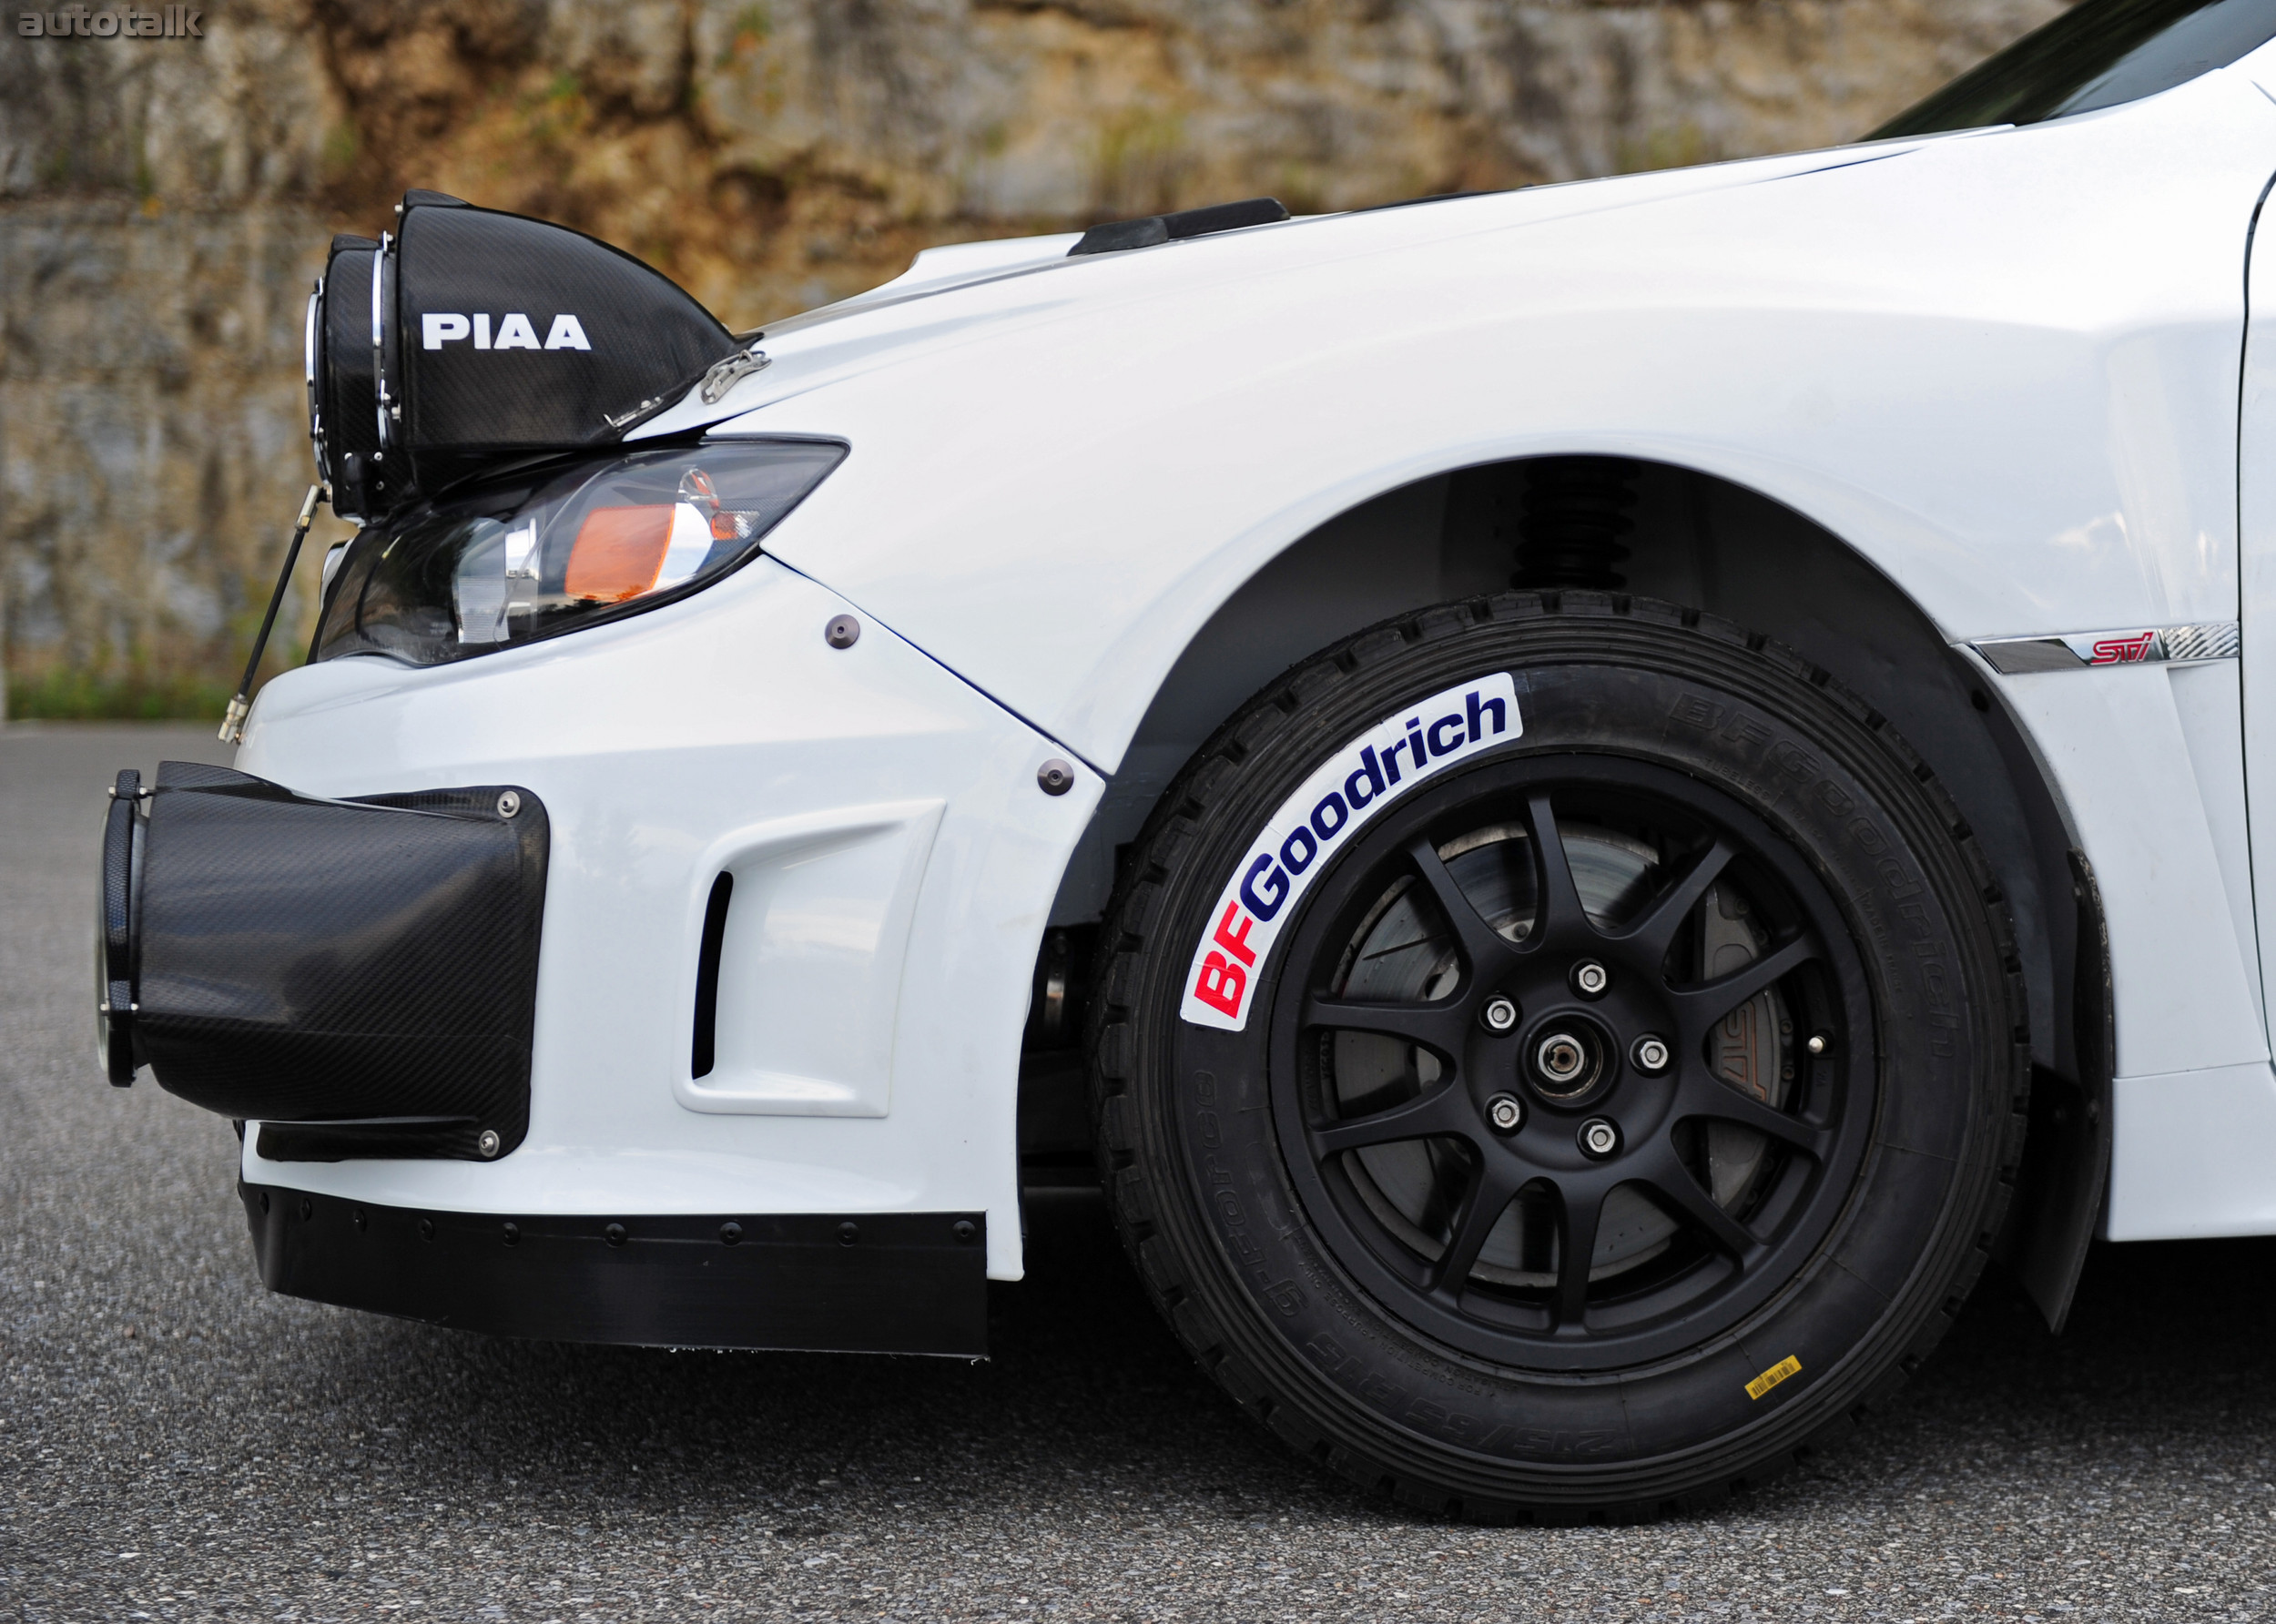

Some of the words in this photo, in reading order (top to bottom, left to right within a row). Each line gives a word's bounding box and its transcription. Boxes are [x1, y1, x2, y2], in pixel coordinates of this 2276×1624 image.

[422, 313, 591, 350] PIAA
[1194, 692, 1506, 1020] BFGoodrich
[1671, 689, 1962, 1059] BFGoodrich
